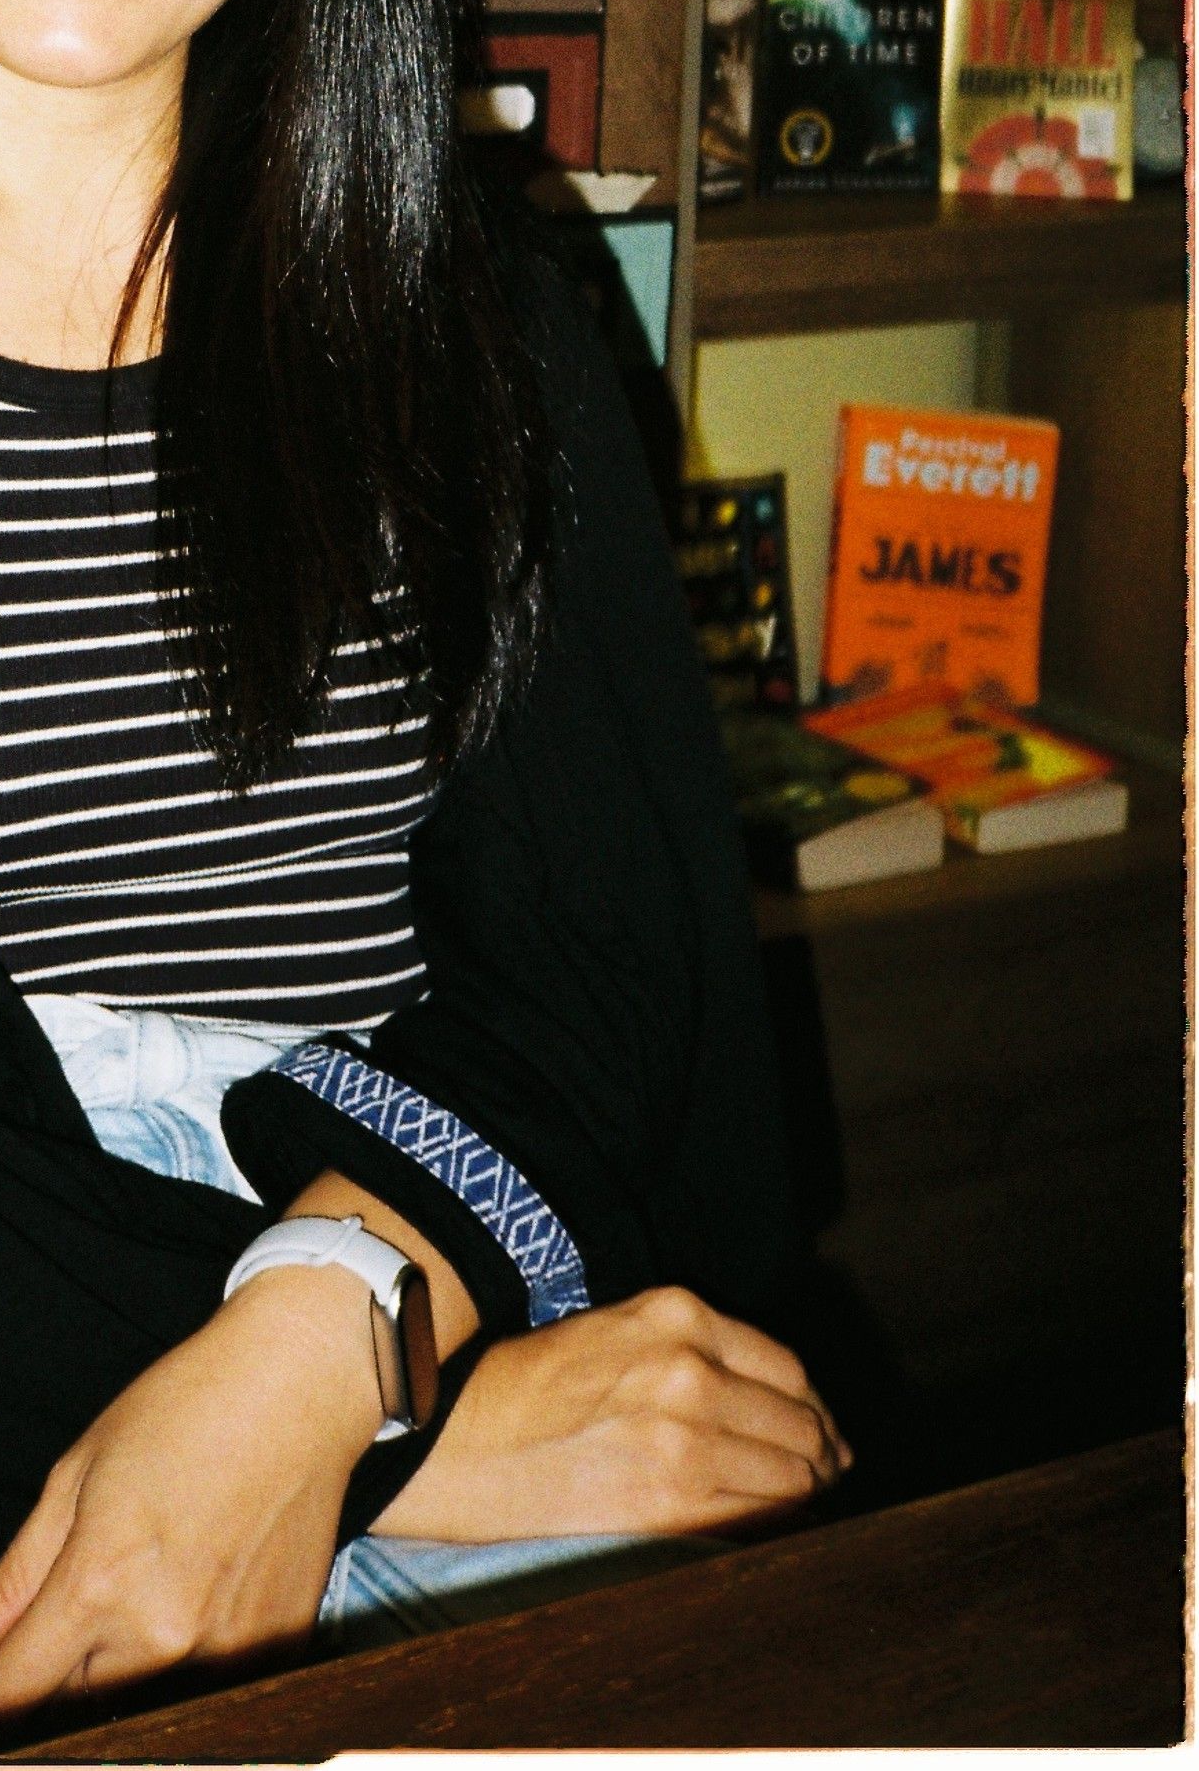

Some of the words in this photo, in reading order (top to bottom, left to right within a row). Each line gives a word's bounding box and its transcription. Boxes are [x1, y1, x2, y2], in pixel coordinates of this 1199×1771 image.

[792, 43, 829, 65] OF
[849, 41, 915, 64] TIME
[969, 0, 1117, 69] HALL
[862, 440, 1040, 502] Everett
[860, 537, 1021, 595] JAMES
